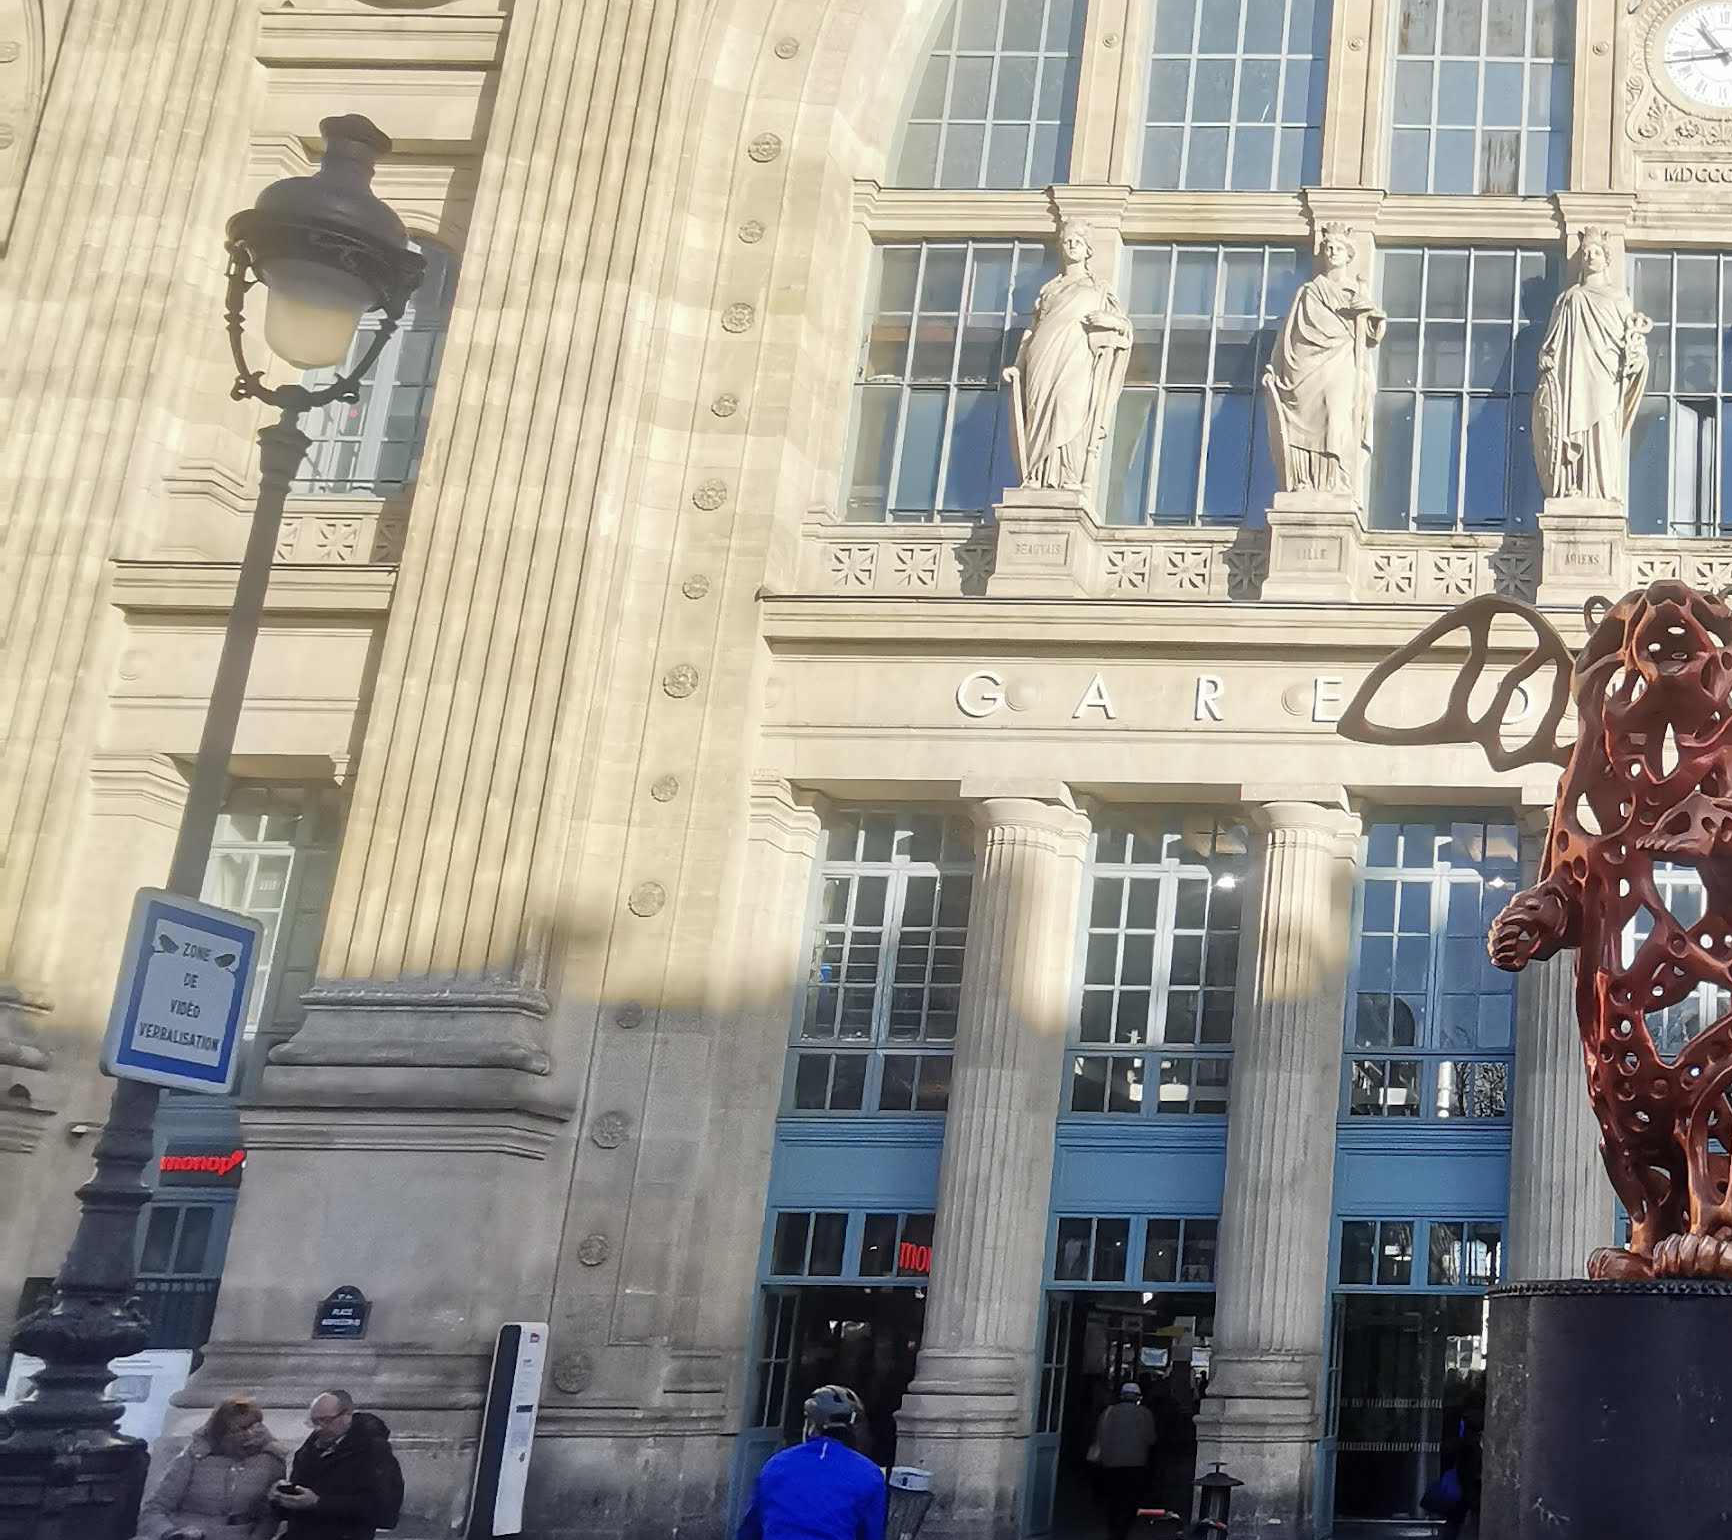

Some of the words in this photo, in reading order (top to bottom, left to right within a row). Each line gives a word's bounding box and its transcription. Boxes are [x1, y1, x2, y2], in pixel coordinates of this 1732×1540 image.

[955, 670, 1343, 723] GARE
[182, 942, 212, 962] ZONE
[183, 972, 199, 989] DE
[169, 998, 201, 1019] VIDÉO
[138, 1021, 220, 1053] VERBALISATION
